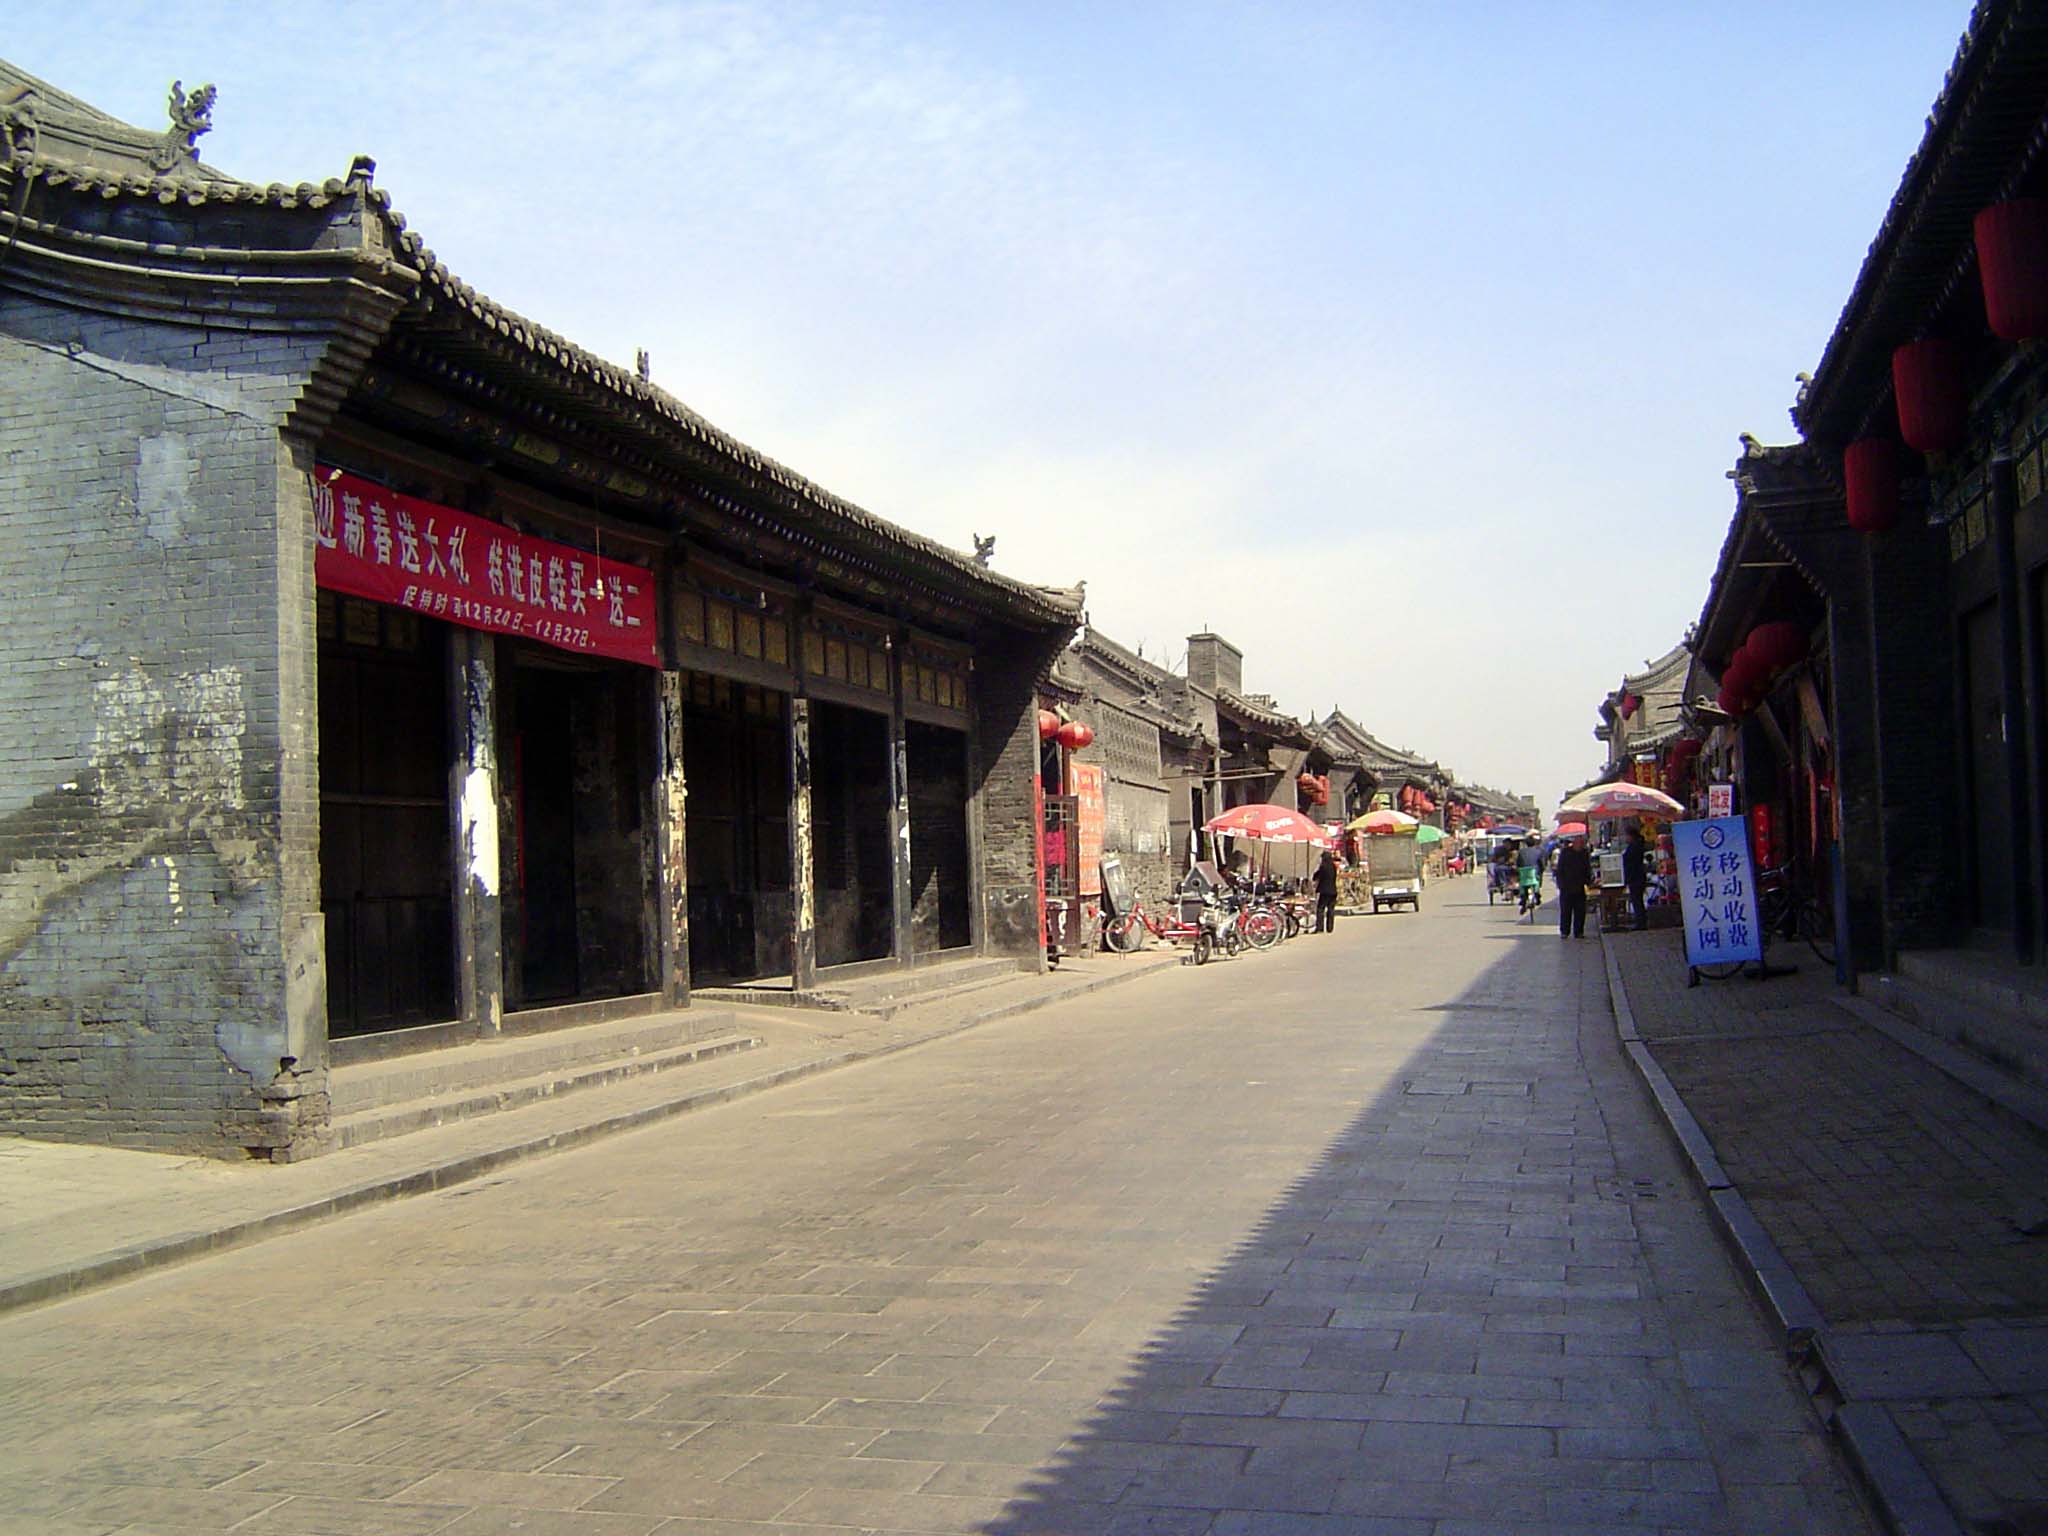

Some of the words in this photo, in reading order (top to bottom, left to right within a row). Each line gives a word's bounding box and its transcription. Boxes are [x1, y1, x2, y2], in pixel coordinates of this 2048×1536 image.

[1690, 853, 1720, 950] 移动入网
[1719, 851, 1749, 947] 移动收费
